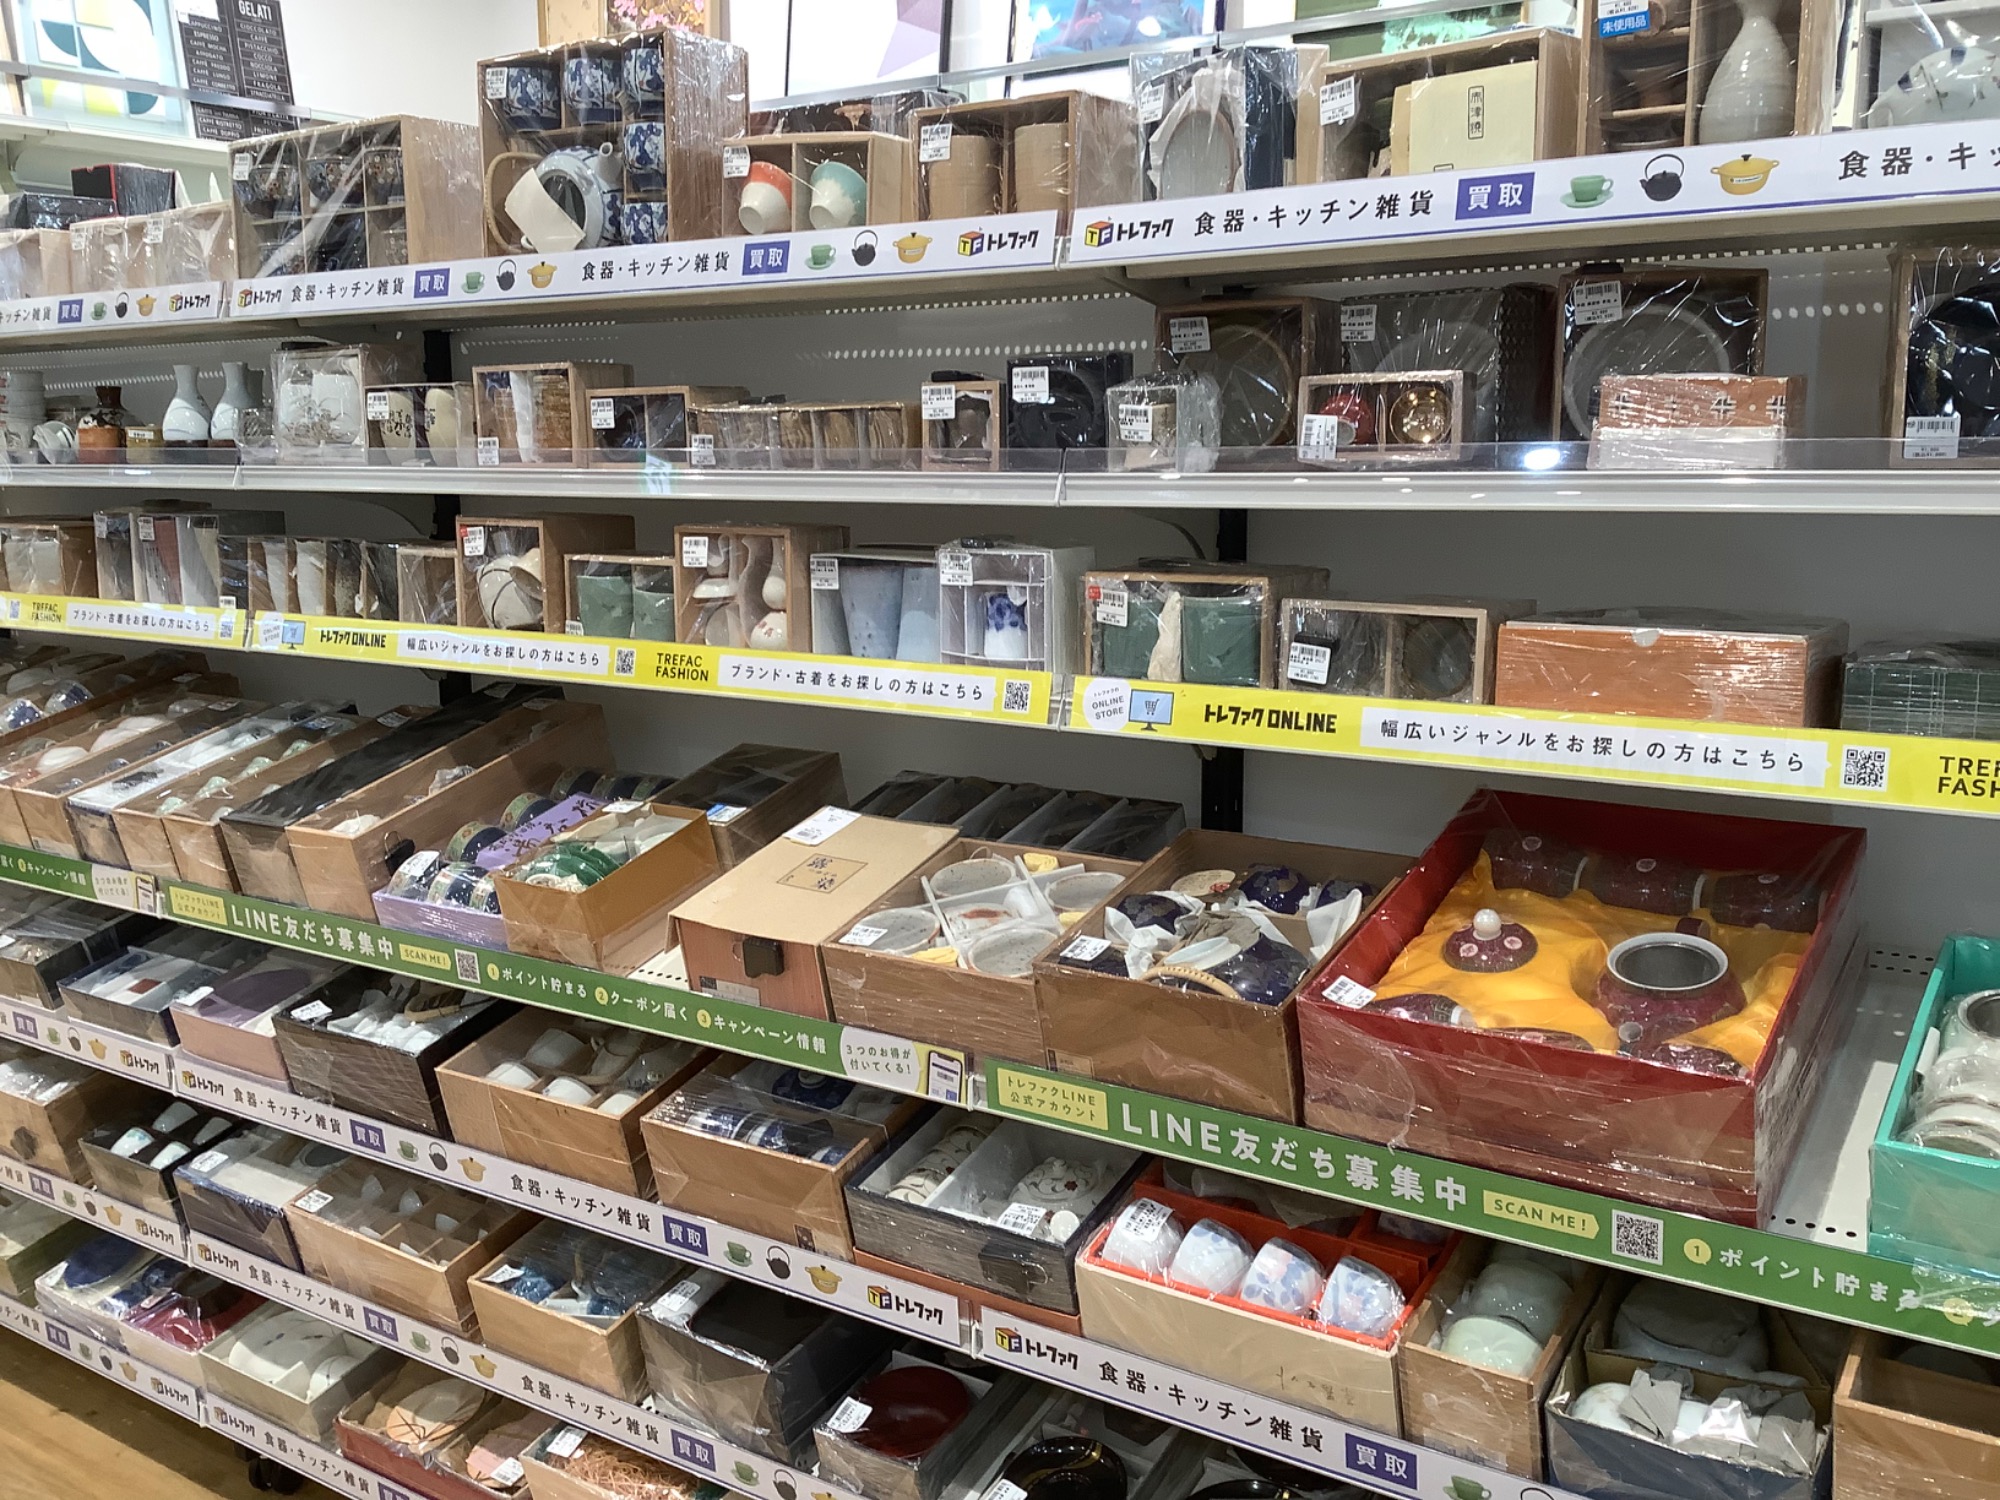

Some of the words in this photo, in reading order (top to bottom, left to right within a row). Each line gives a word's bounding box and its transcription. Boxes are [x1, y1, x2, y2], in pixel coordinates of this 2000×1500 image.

[239, 0, 272, 21] GELATI
[1602, 15, 1647, 34] 未使用品
[1117, 218, 1174, 241] トレファク
[1194, 189, 1434, 237] 食器・キッチン雑貨
[1467, 182, 1524, 211] 買取
[582, 251, 730, 282] 食器・キッチン雑貨
[749, 247, 783, 269] 買取
[986, 229, 1039, 252] トレファク
[291, 278, 404, 302] 食器・キッチン雑貨
[418, 273, 446, 292] 買取
[656, 666, 709, 682] FASHION
[657, 652, 703, 668] TREFAC
[731, 663, 984, 702] ブランド・古着をお探しの方はこちら
[1092, 695, 1125, 710] ONLINE
[1095, 706, 1125, 721] STORE
[1381, 719, 1804, 773] 幅広いジャンルをお探しの方はこちら
[404, 948, 428, 960] SCAN
[502, 967, 587, 999] ポイント貯まる
[611, 990, 688, 1021] クーポン届く
[714, 1014, 827, 1055] キャンペーン情報
[1010, 1091, 1097, 1122] 公式アカウント
[232, 1087, 342, 1136] 食器・キッチン雑貨
[354, 1125, 382, 1147] 買取
[510, 1173, 652, 1233] 食器・キッチン雑貨
[669, 1221, 703, 1249] 買取
[895, 1294, 943, 1325] トレファク
[1494, 1199, 1544, 1223] SCAN
[1549, 1211, 1587, 1234] ME!
[1719, 1247, 1921, 1313] ポイント貯まる
[248, 1265, 356, 1321] 食器・キッチン雑貨
[367, 1312, 394, 1336] 買取
[521, 1374, 660, 1446] 食器・キッチン雑貨
[676, 1435, 711, 1464] 買取
[1025, 1337, 1078, 1370] トレファク
[1099, 1361, 1324, 1454] 食器・キッチン雑貨
[1355, 1443, 1408, 1480] 買取
